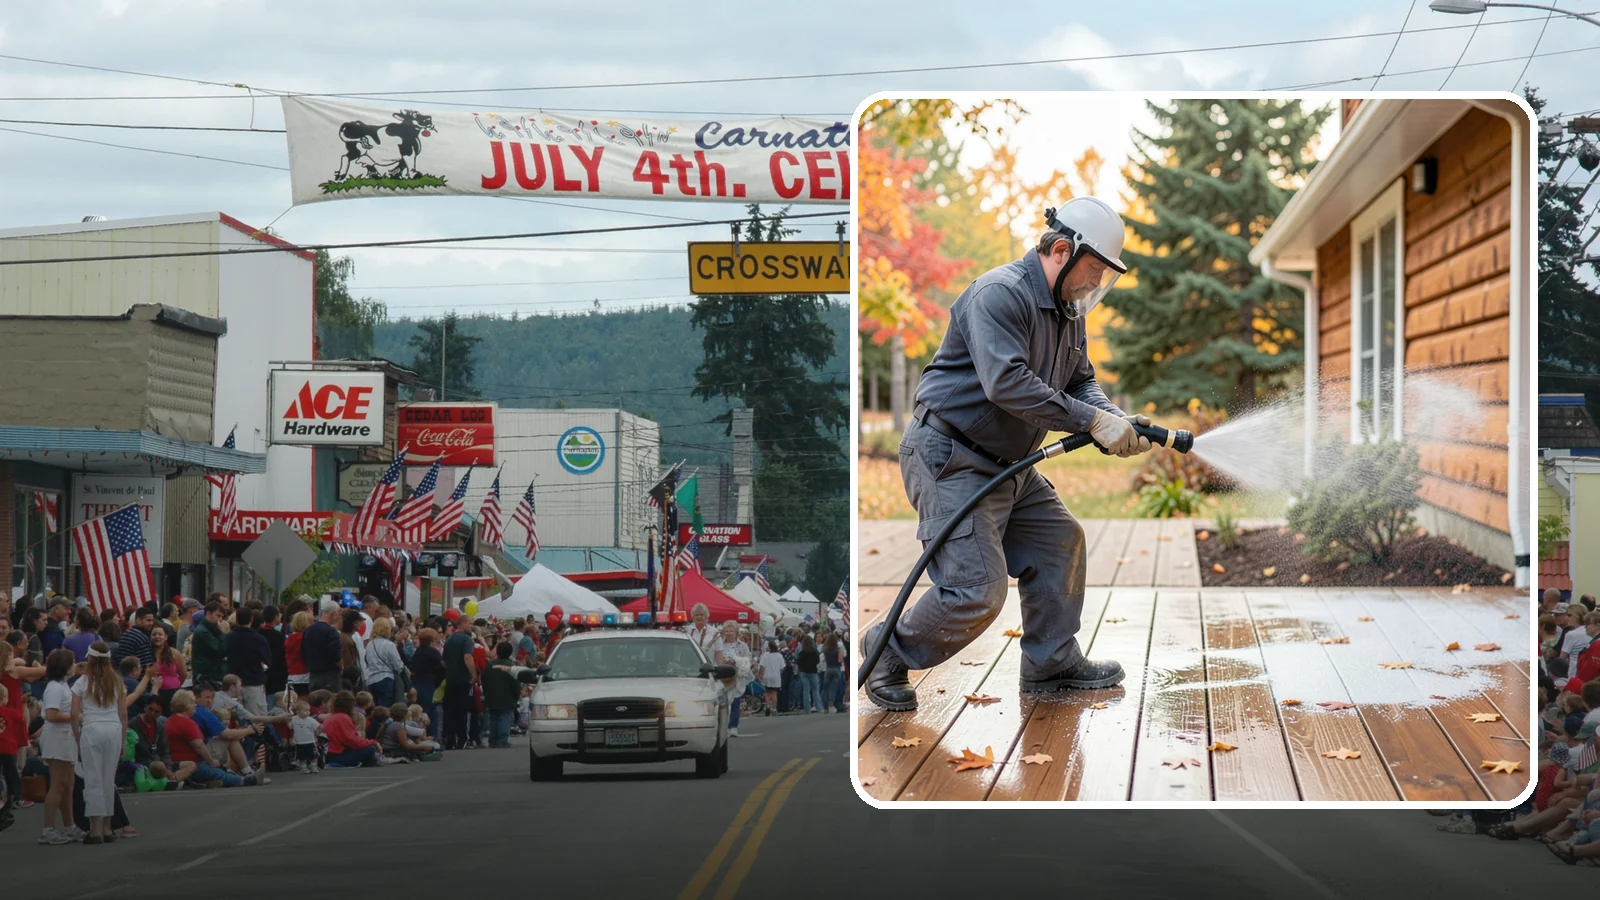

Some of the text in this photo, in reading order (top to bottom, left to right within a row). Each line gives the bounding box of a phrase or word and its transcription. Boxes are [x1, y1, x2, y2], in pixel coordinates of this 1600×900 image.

[481, 141, 604, 192] JULY
[632, 150, 746, 198] 4th.
[697, 254, 850, 280] CROSSWA
[283, 380, 373, 420] ACE
[406, 409, 485, 421] CEDAR LOG
[284, 421, 370, 436] Hardware
[416, 428, 476, 447] Coca-Cola
[83, 485, 155, 495] St. Vincent de Paul
[212, 515, 331, 536] HARDARE
[688, 526, 741, 535] CRNATION
[699, 535, 730, 543] GLASS
